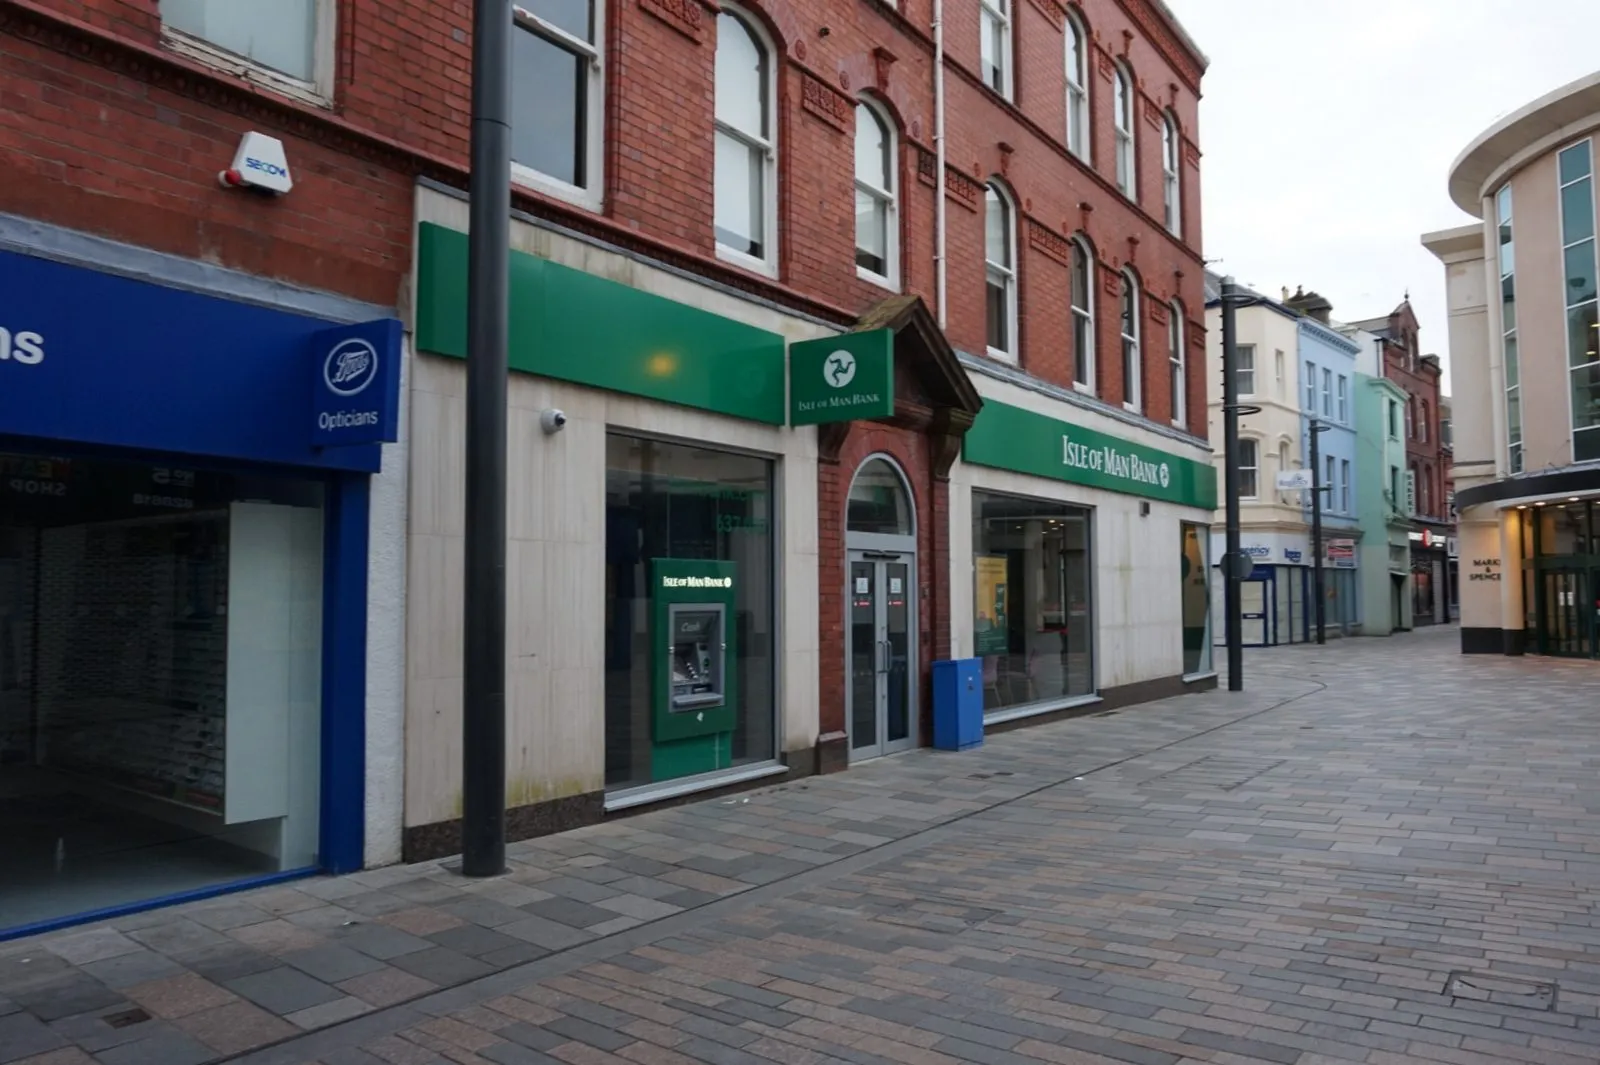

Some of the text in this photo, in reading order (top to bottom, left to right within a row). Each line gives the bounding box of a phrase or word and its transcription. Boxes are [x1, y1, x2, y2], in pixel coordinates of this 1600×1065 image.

[246, 157, 287, 178] SECOM
[331, 350, 369, 383] Boots
[798, 400, 816, 412] ISLE
[829, 396, 851, 407] MAN
[852, 393, 880, 405] BANK
[318, 408, 378, 431] Opticians
[1062, 434, 1159, 485] ISLE OF MAN BANK
[663, 576, 678, 587] ISLE
[687, 576, 704, 588] MAN
[704, 576, 724, 588] BANK
[1469, 573, 1501, 581] SPENCE
